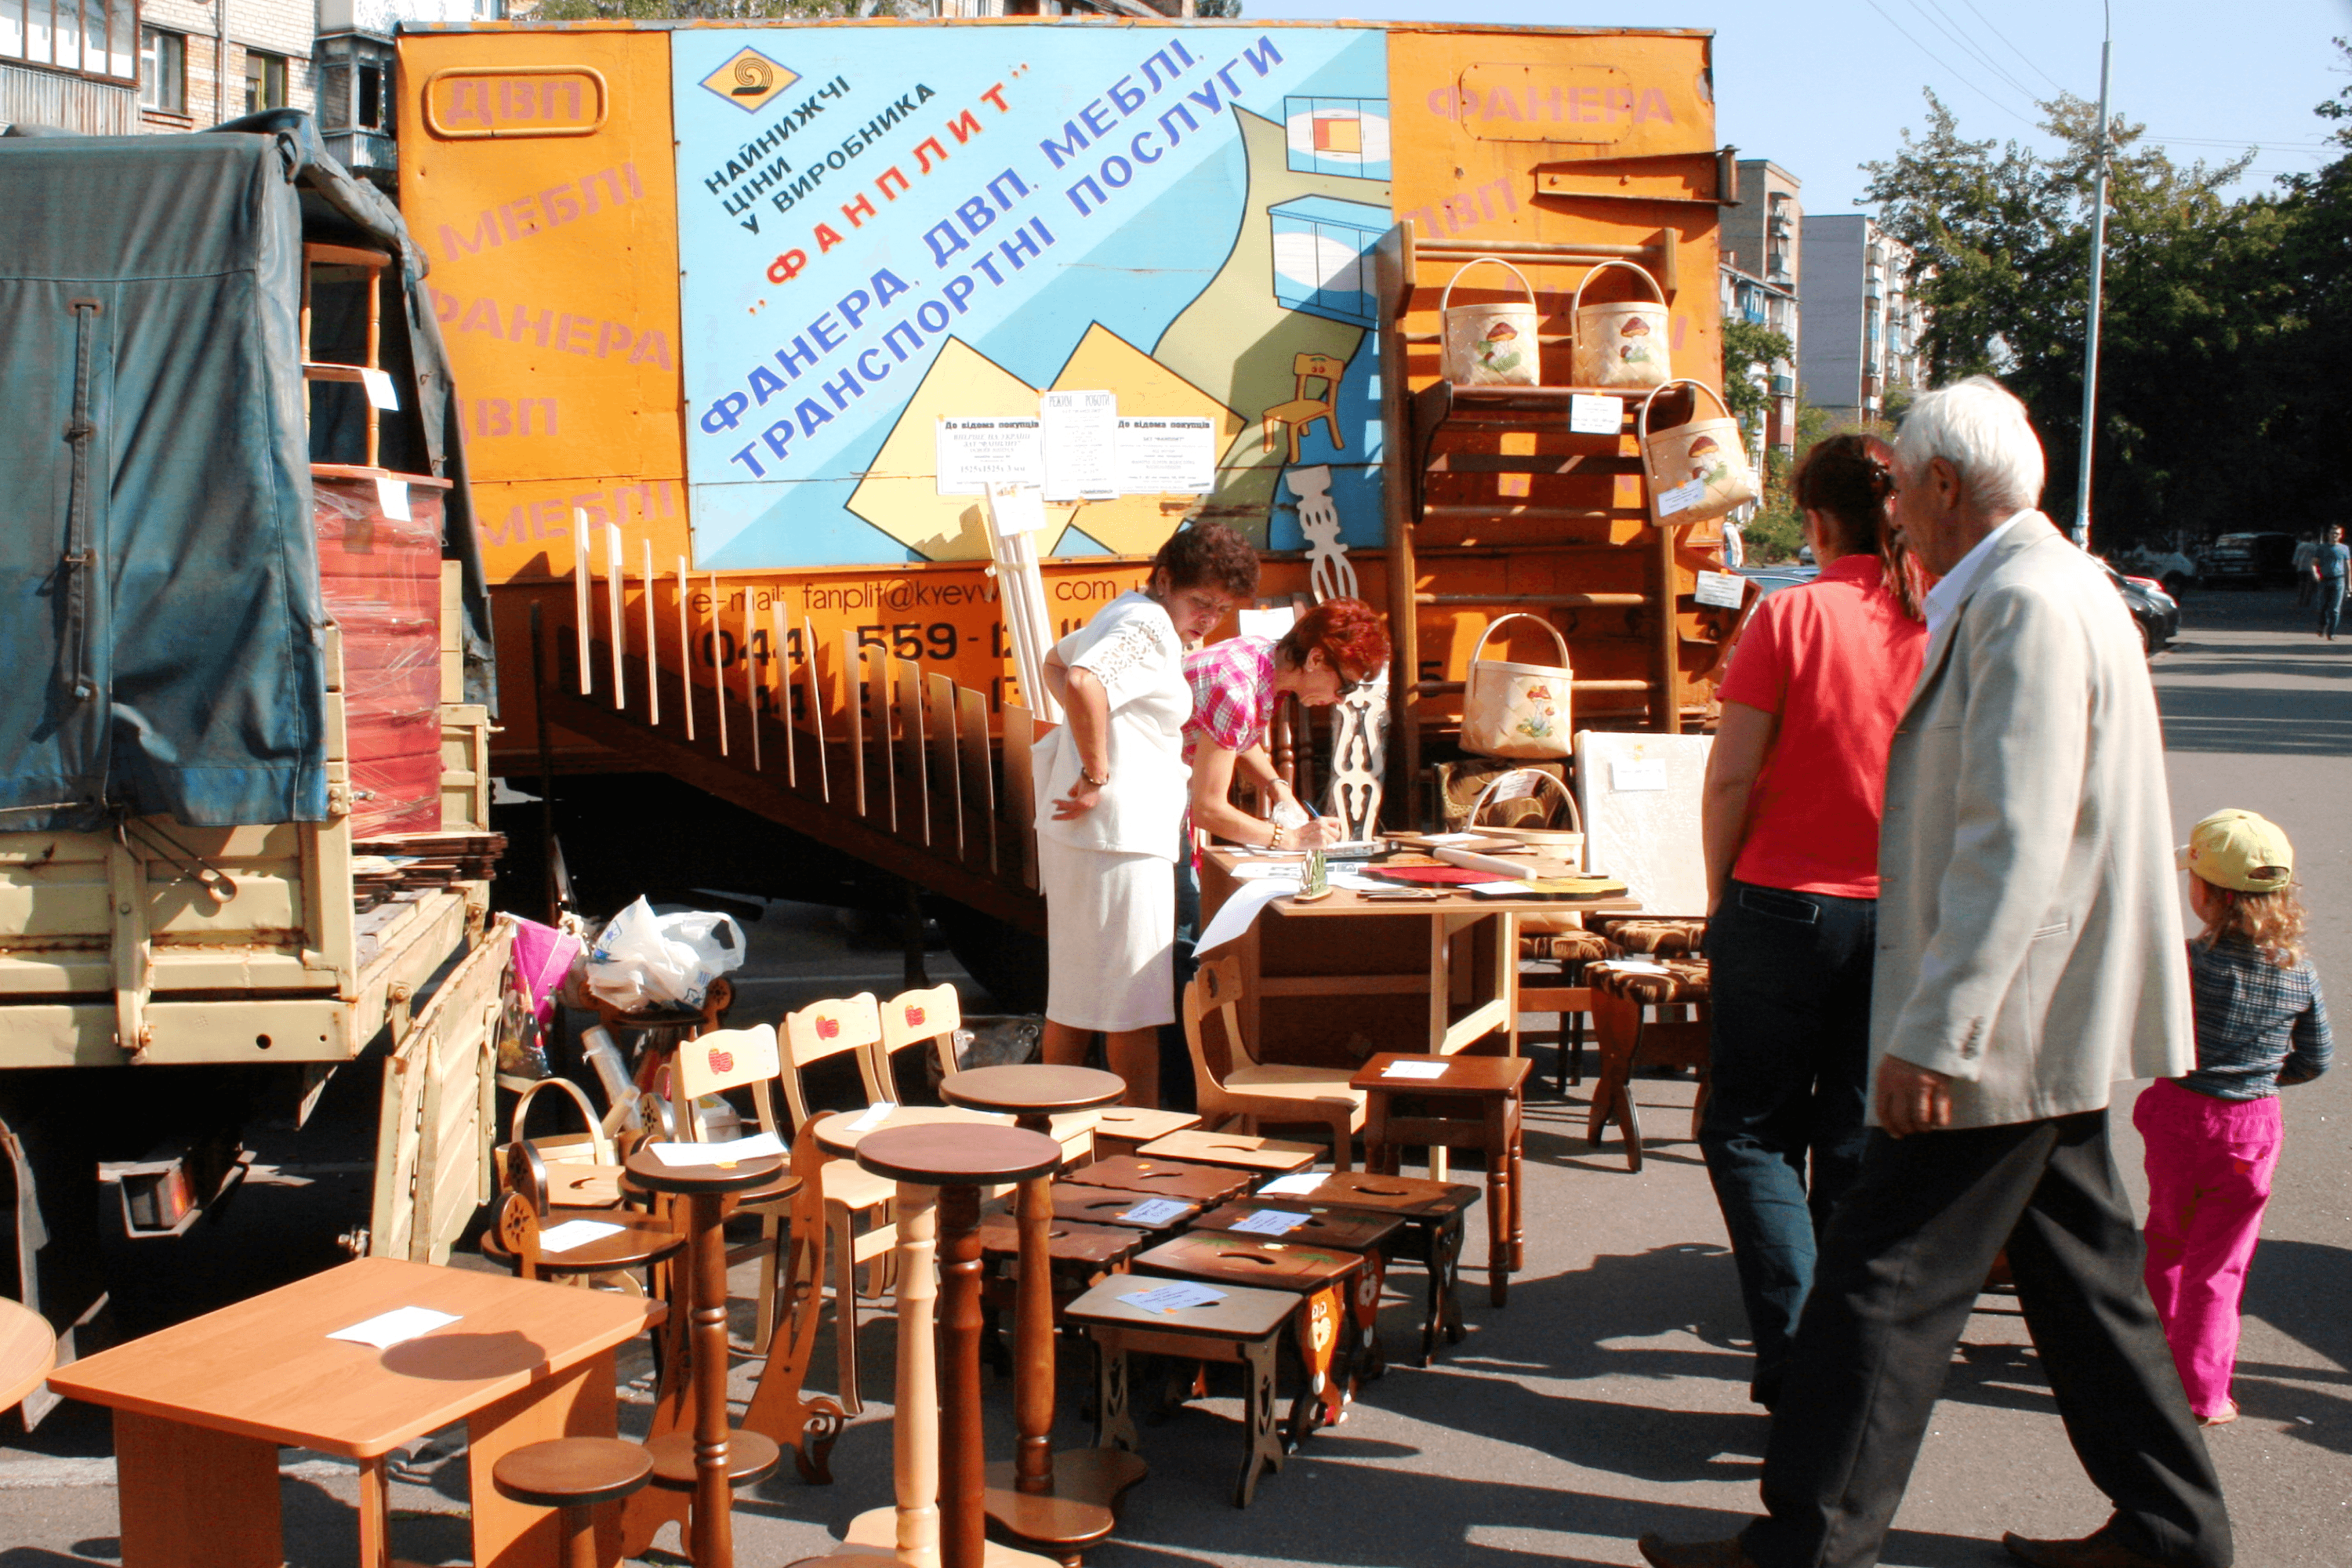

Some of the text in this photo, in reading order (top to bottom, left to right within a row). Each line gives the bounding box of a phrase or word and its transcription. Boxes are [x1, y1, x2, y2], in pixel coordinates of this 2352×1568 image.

[445, 80, 582, 126] ДВП
[1427, 84, 1675, 124] ФАНЕРА
[706, 74, 851, 197] НАЙНИЖЧІ
[741, 82, 937, 237] У ВИРОБНИКА
[722, 156, 794, 218] ЦІНИ
[437, 162, 646, 263] МЕБЛІ
[730, 35, 1286, 481] ТРАНСПОРТНІ ПОСЛУГИ
[457, 397, 558, 445] ВП
[1049, 394, 1109, 407] РЕЖИМ РОБОТИ
[1118, 419, 1130, 429] До
[1134, 420, 1167, 429] відома
[961, 421, 995, 430] відома
[998, 420, 1040, 430] покупців
